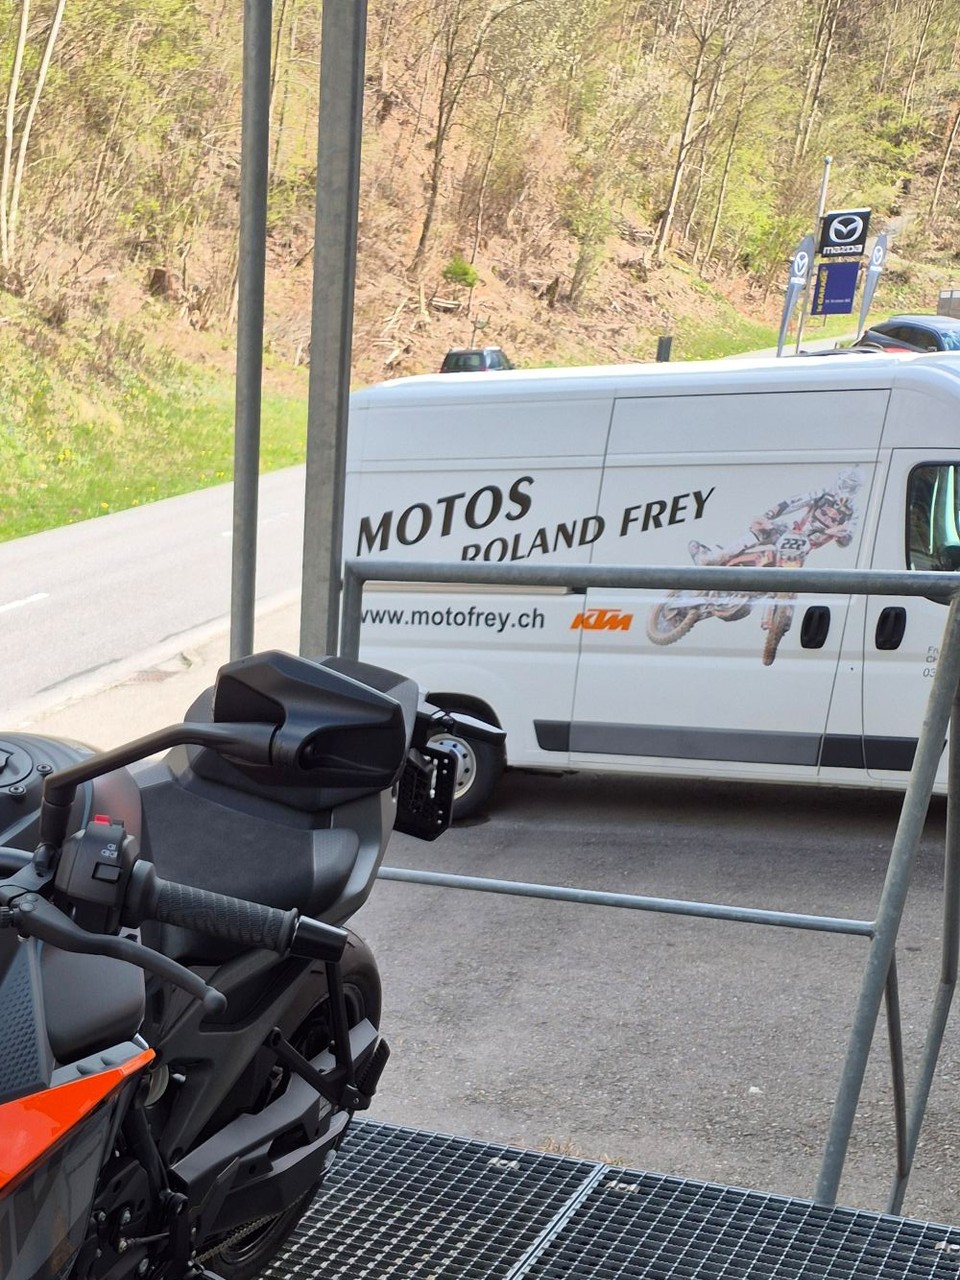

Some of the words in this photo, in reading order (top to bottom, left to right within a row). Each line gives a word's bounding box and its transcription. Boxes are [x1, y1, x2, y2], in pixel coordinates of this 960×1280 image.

[356, 476, 535, 557] MOTOS
[461, 515, 606, 562] ROLAND
[619, 487, 715, 537] FREY
[780, 538, 807, 550] 222
[569, 608, 633, 631] KTM
